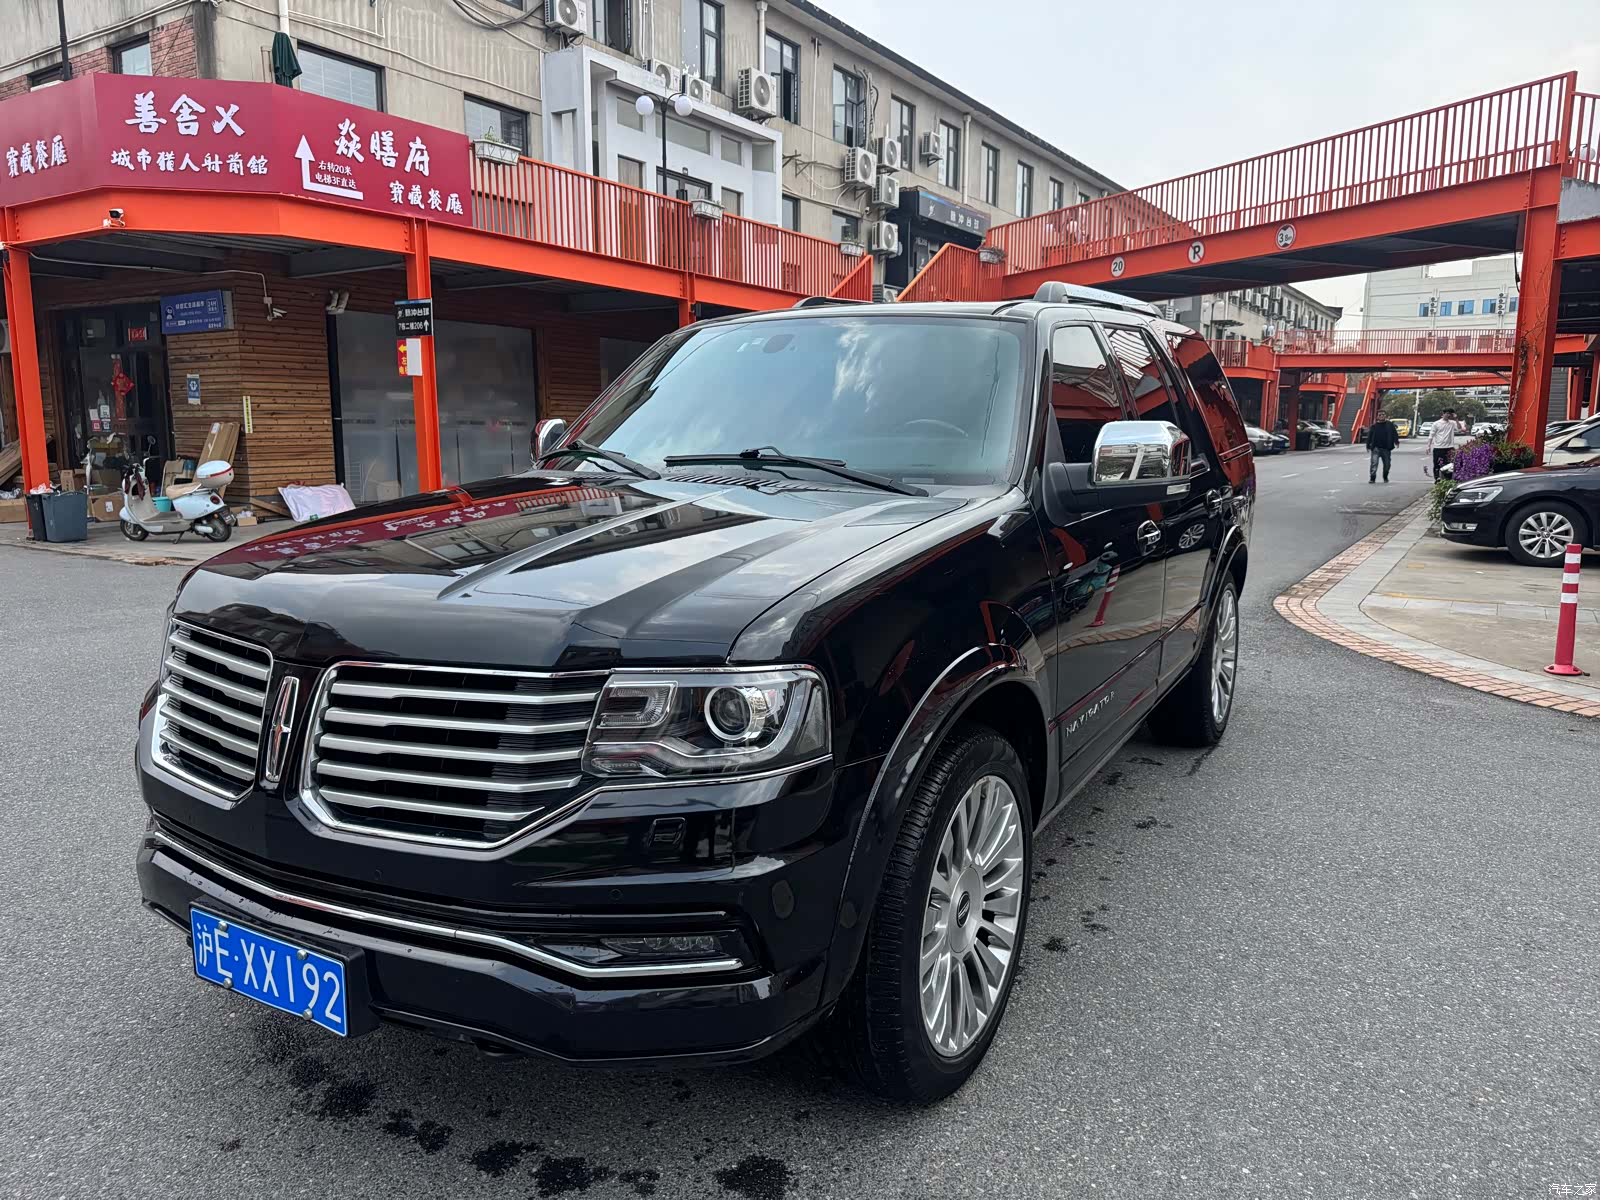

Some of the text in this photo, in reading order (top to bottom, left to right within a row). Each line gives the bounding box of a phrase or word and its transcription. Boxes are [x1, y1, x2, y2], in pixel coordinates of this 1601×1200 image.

[318, 160, 352, 176] 右转20米
[315, 172, 357, 189] 电梯3F直达
[1113, 261, 1123, 272] 20
[1066, 690, 1115, 737] NAVIGATOR
